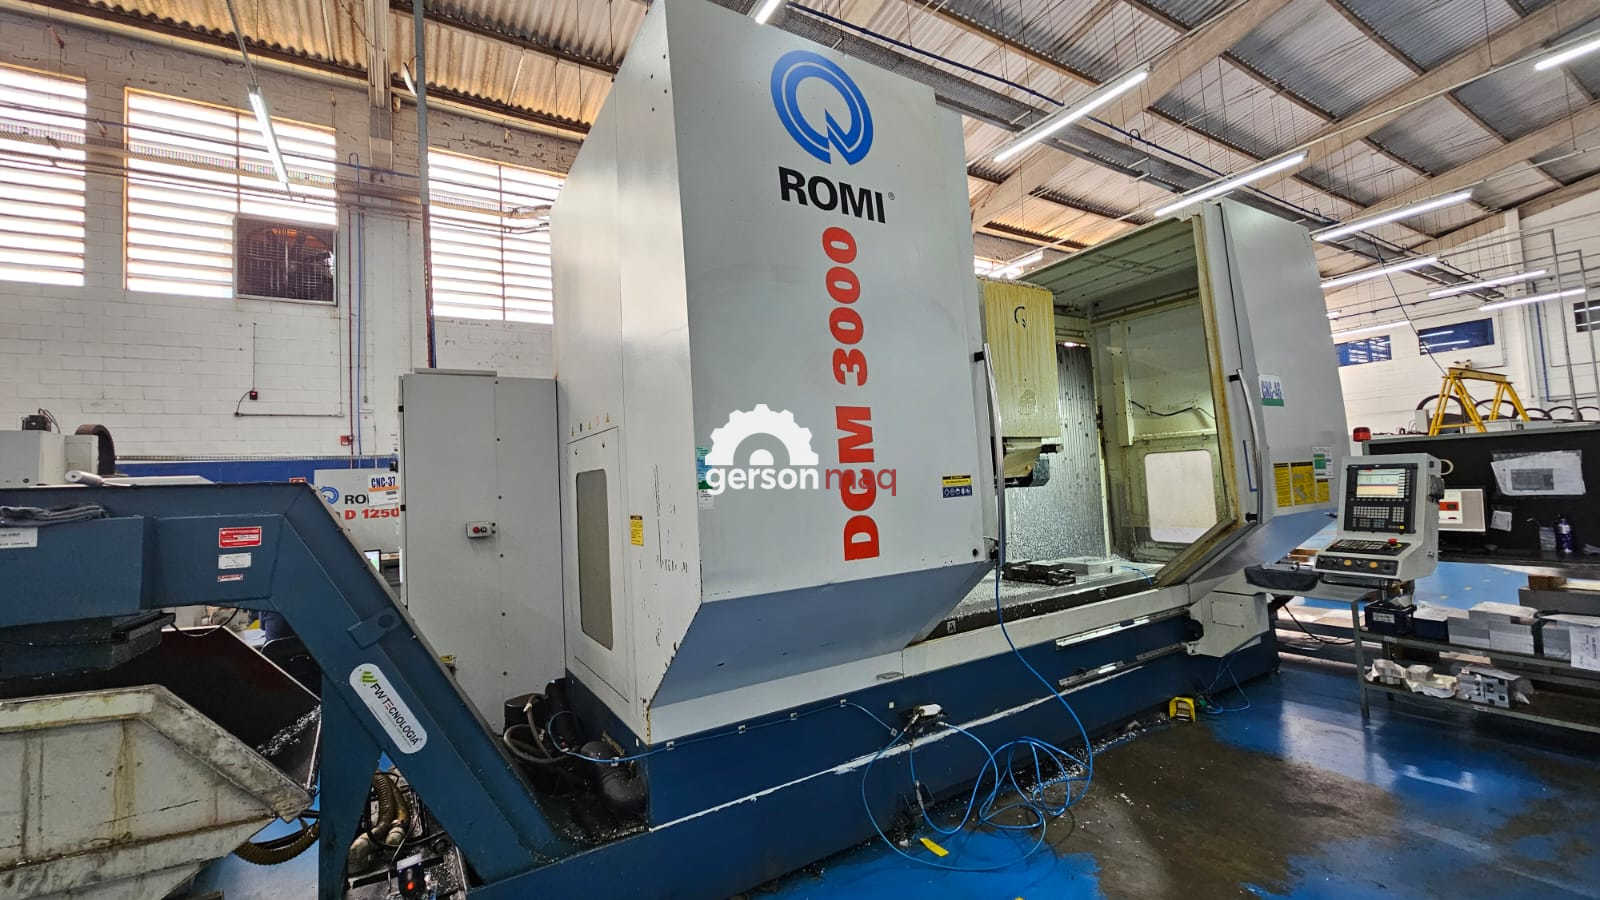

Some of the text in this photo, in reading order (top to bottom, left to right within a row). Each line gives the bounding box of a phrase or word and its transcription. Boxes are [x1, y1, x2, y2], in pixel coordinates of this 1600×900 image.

[822, 226, 880, 562] DCM 3000
[371, 476, 396, 489] CNC-37
[344, 494, 370, 505] RO
